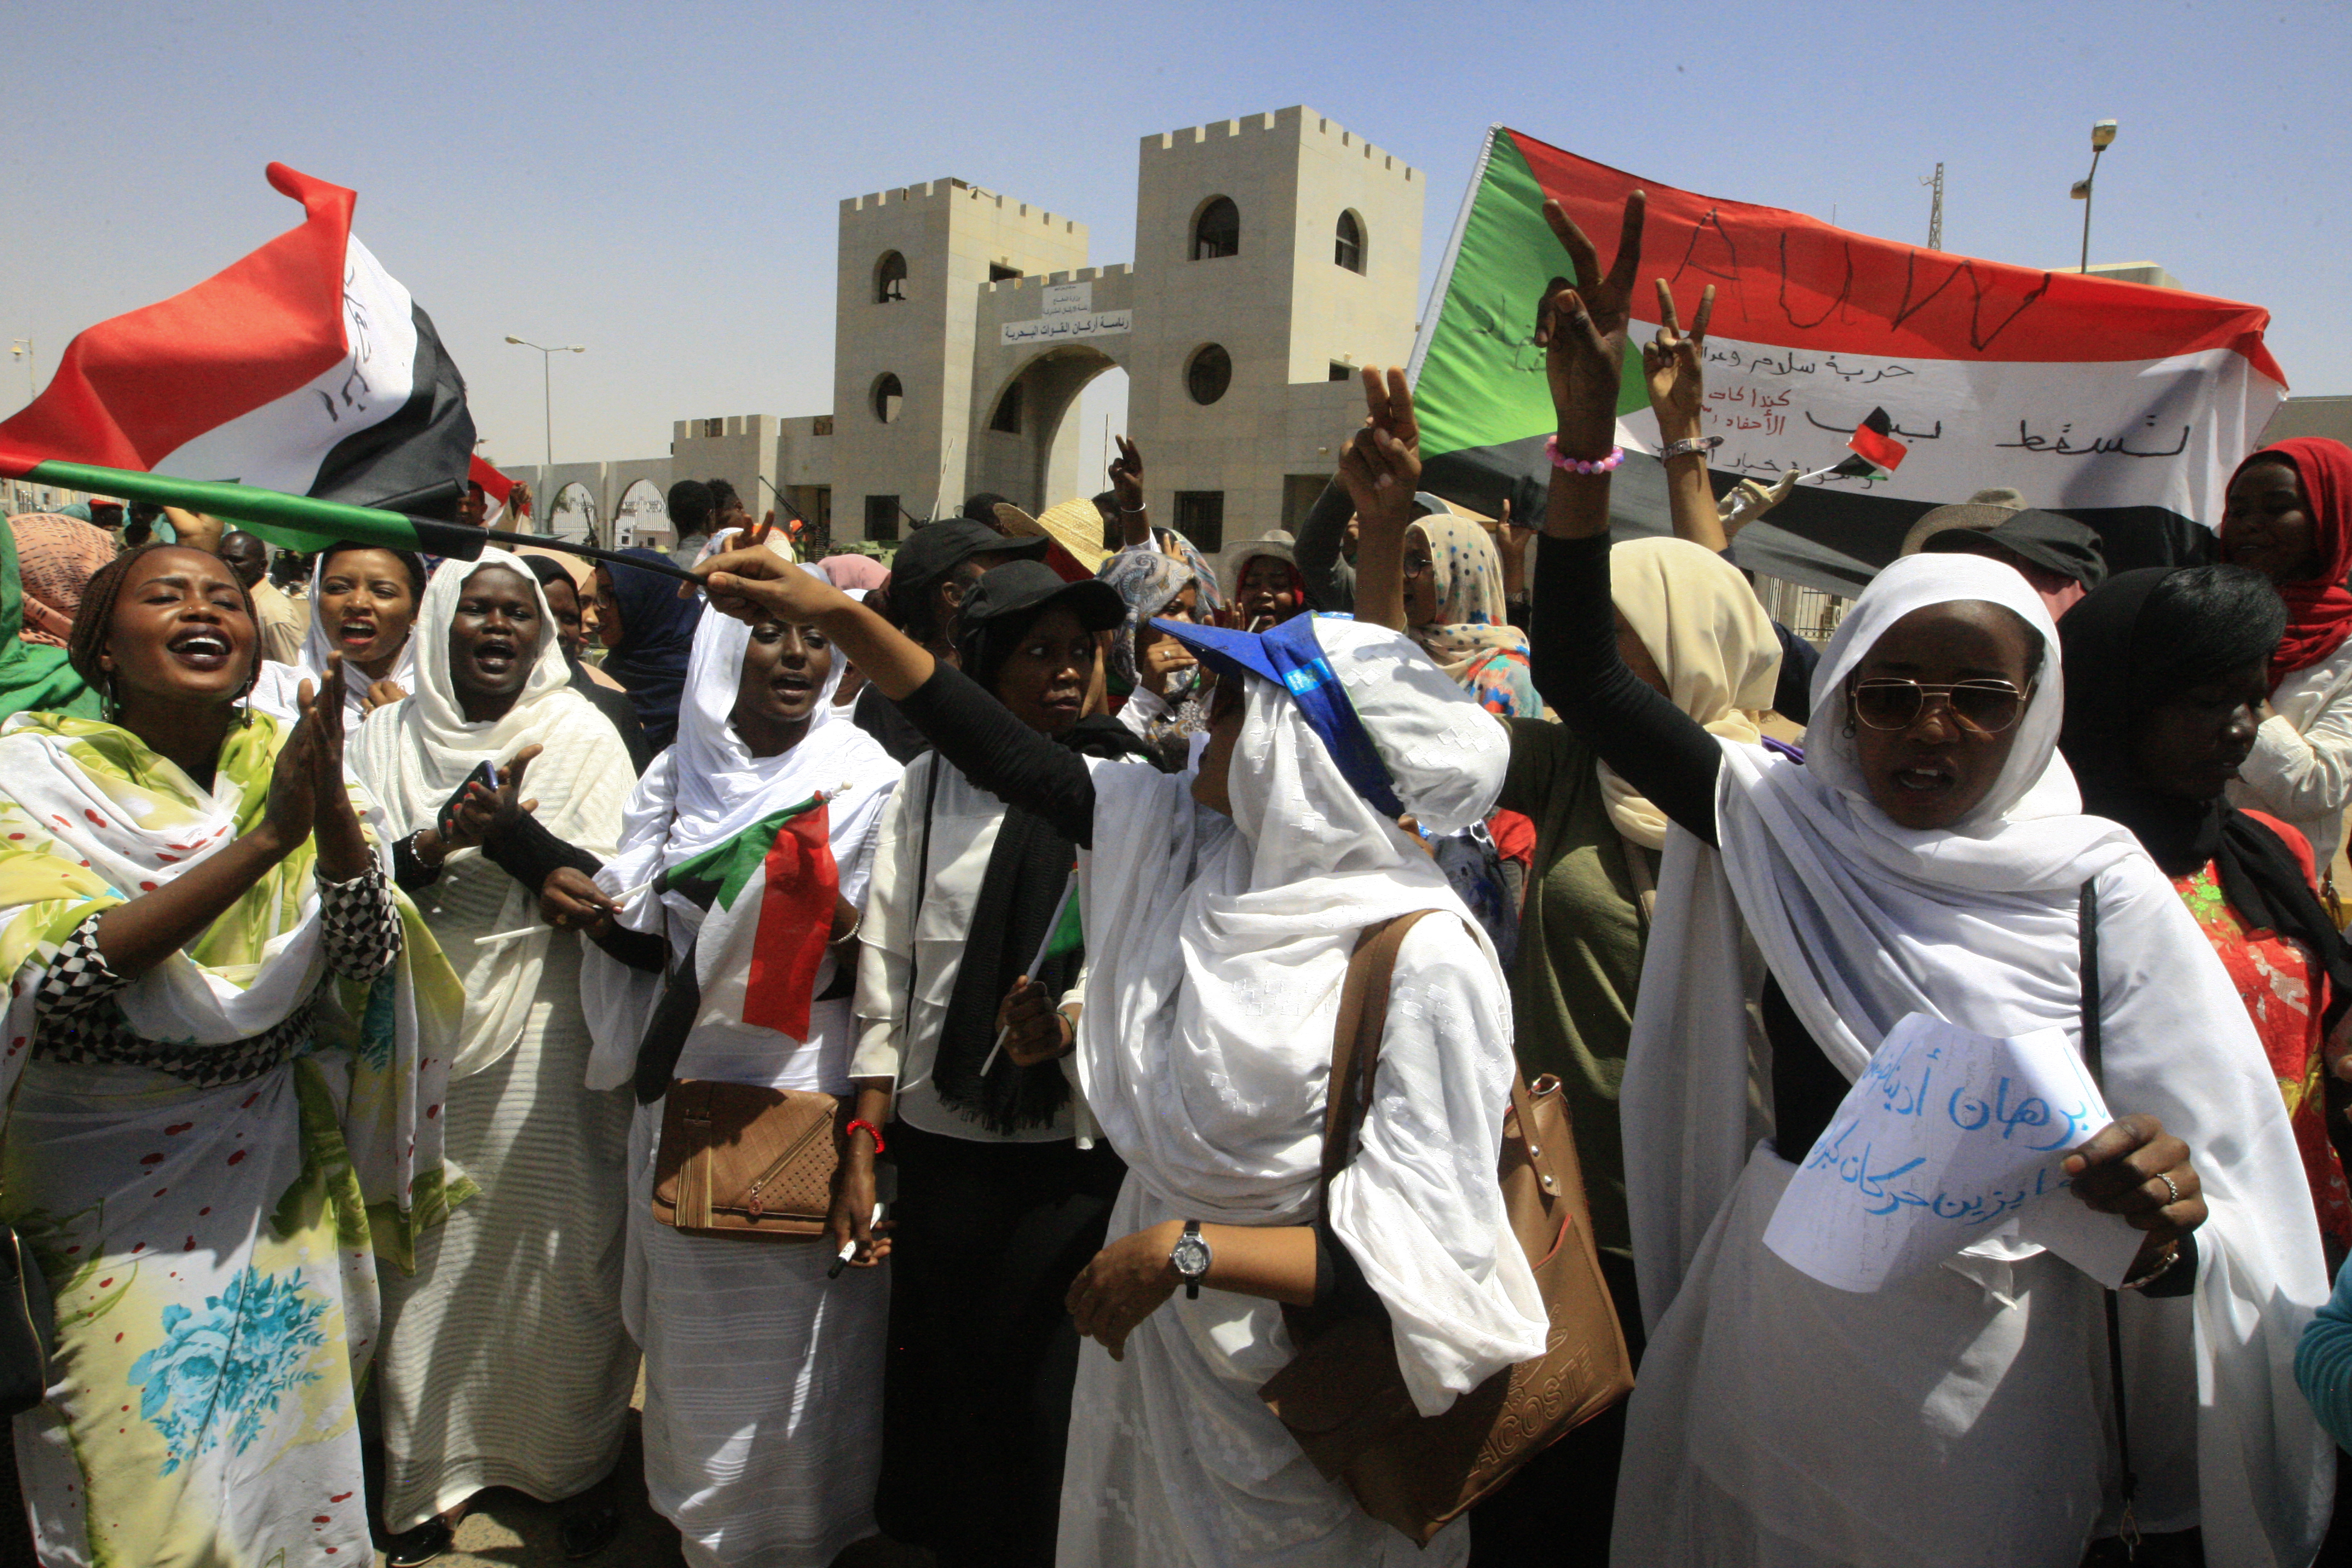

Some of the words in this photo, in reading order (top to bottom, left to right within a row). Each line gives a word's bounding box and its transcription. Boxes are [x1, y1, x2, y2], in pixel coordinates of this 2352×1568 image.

[1040, 322, 1069, 336] القوات
[1749, 352, 1815, 376] سلام
[1824, 354, 1914, 383] حرية
